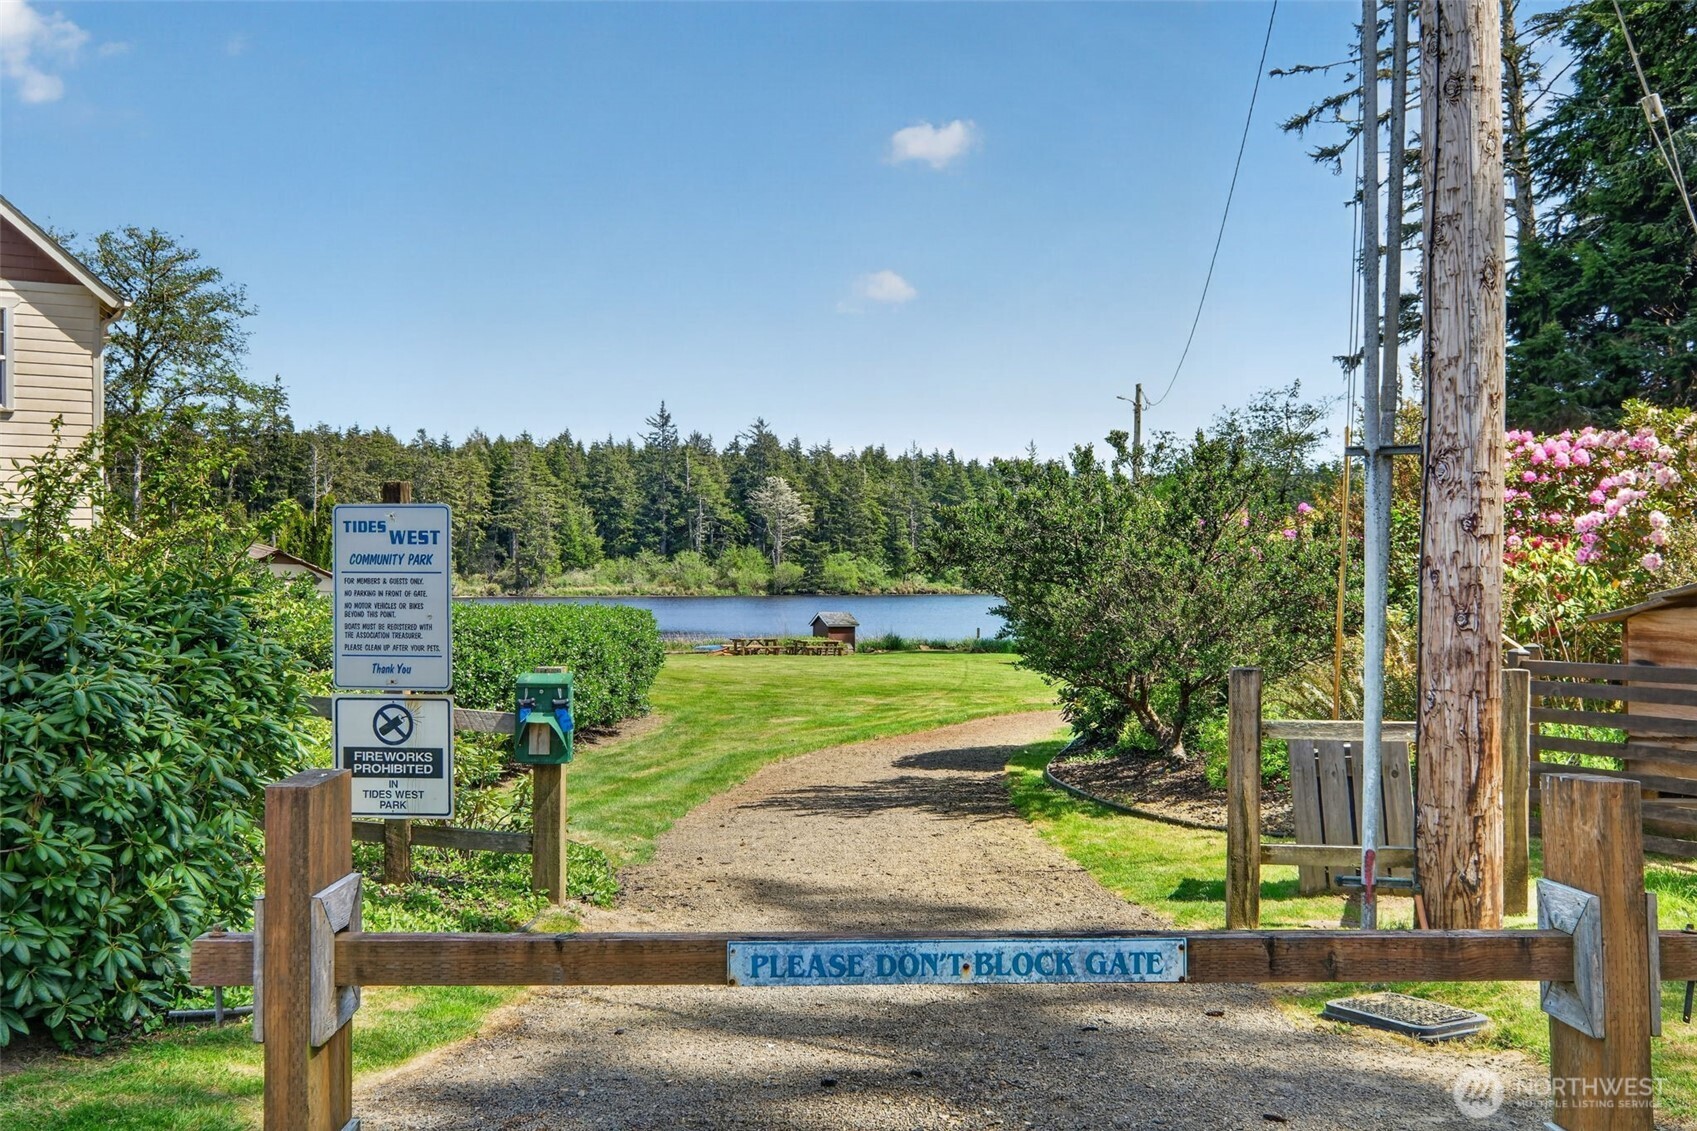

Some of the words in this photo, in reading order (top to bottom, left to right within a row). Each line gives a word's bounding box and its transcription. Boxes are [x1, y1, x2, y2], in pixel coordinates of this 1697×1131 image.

[343, 521, 386, 533] TIDES
[389, 530, 440, 545] WEST
[349, 554, 405, 565] COMMUNITY
[408, 554, 433, 565] PARK
[372, 663, 394, 674] Thank
[397, 663, 412, 674] You
[354, 751, 433, 762] FIREWORKS
[353, 764, 433, 774] PROHIBITED
[389, 780, 398, 788] IN
[363, 790, 392, 798] TIDES
[395, 791, 424, 799] WEST
[380, 801, 407, 809] PARK
[750, 954, 865, 978] PLEASE
[876, 953, 966, 978] DON'T
[975, 952, 1075, 976] BLOCK
[1085, 952, 1165, 976] GATE
